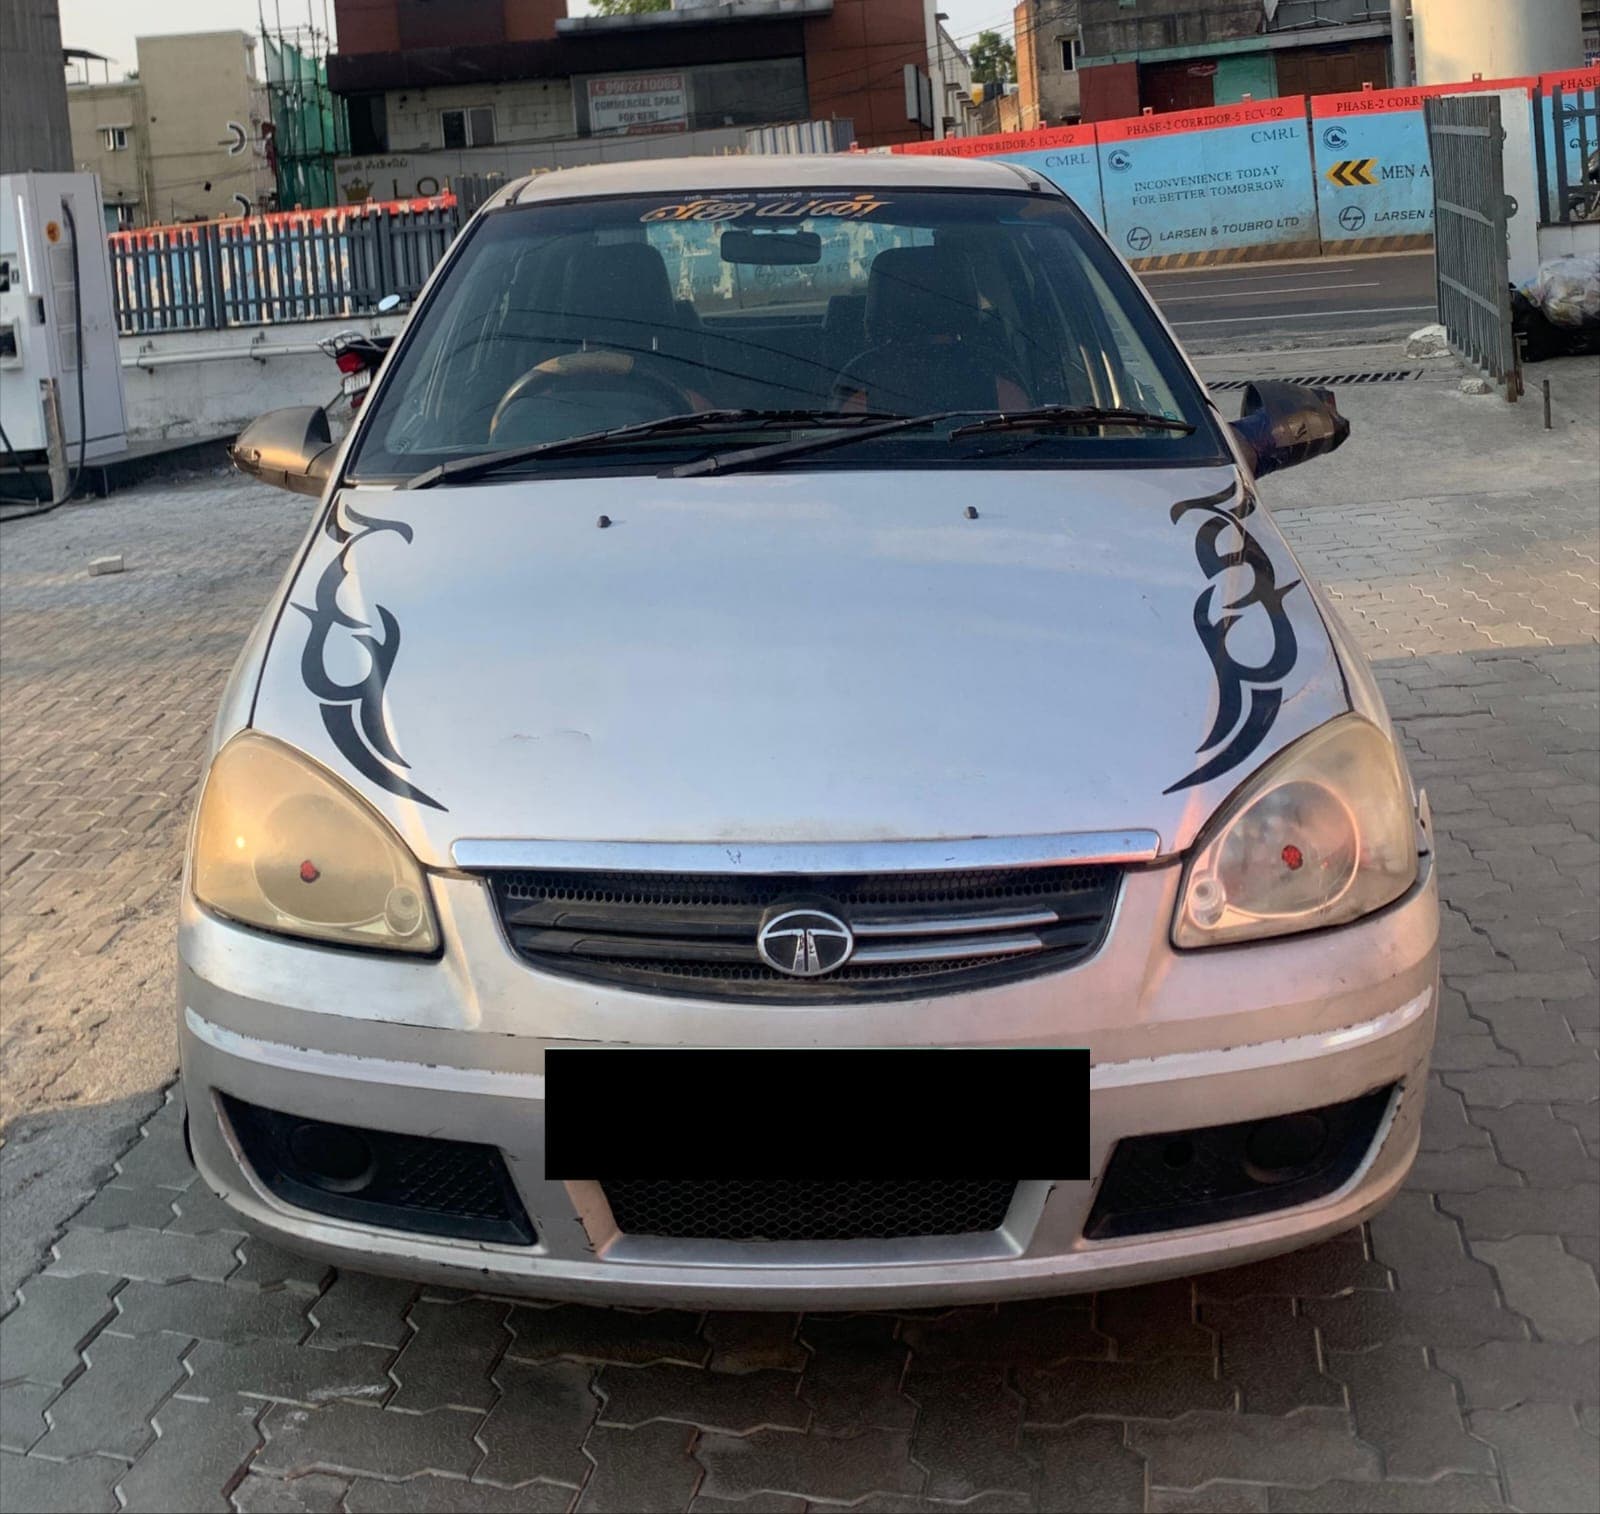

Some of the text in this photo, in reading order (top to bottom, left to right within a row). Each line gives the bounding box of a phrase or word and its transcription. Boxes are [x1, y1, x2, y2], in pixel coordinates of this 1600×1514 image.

[595, 95, 680, 110] COMMERCIAL SPACE
[1336, 98, 1385, 113] PHASE-2
[618, 110, 660, 122] FOR RENT
[1126, 107, 1284, 136] PHASE-2 CORRIDOR-5 ECV-02
[1251, 127, 1300, 143] CMRL
[974, 139, 1035, 154] CORRIDOR-5
[1039, 134, 1075, 147] ECV-02
[1045, 153, 1091, 168] CMRL
[1134, 165, 1280, 192] INCONVENIENCE TODAY
[1381, 165, 1417, 180] MEN
[1132, 179, 1285, 207] FOR BETTER TOMORROW
[1374, 209, 1426, 222] LARSEN
[1159, 215, 1300, 241] LARSEN & TOUBRO LTD
